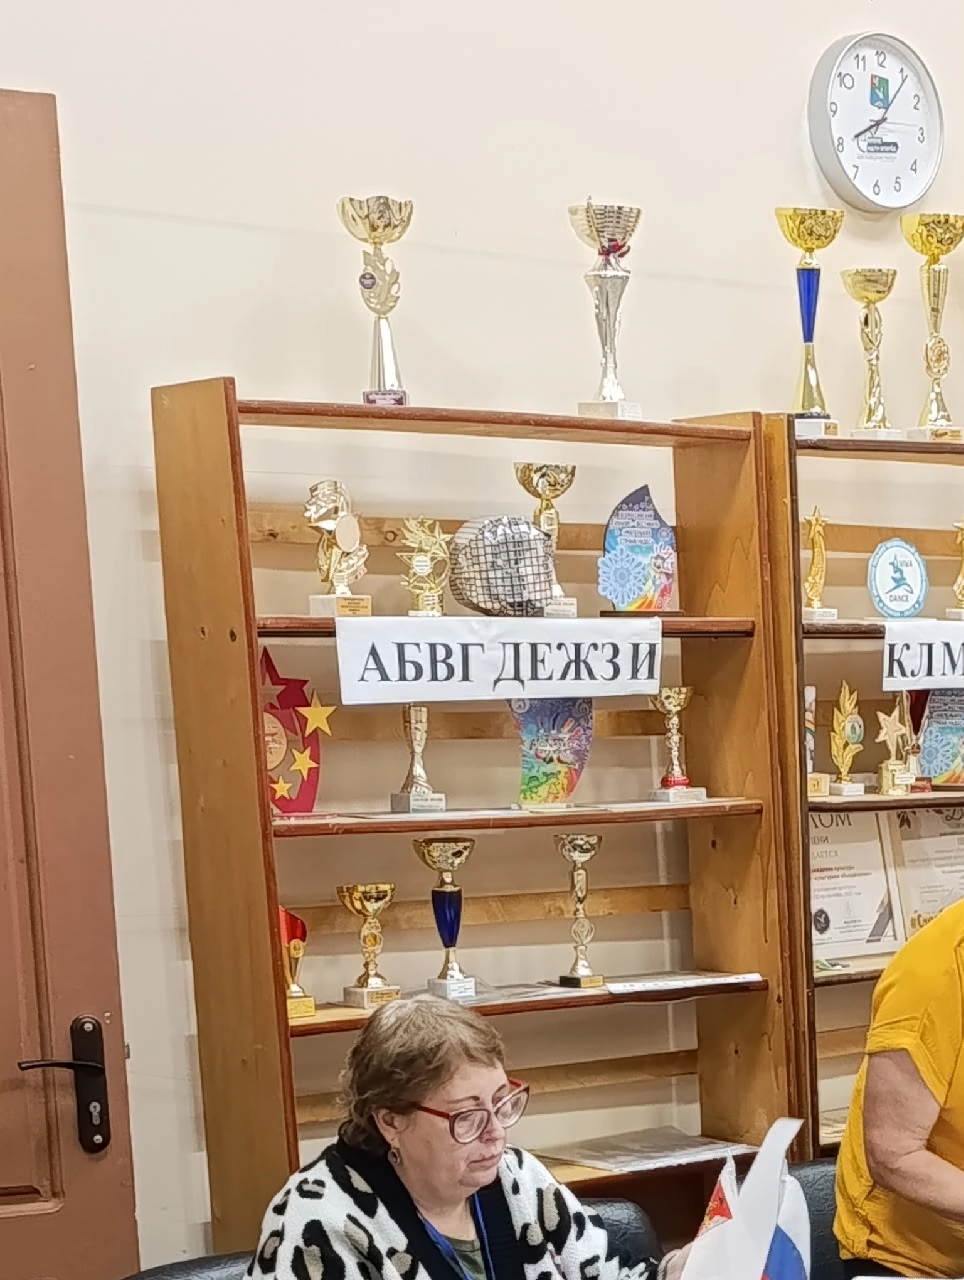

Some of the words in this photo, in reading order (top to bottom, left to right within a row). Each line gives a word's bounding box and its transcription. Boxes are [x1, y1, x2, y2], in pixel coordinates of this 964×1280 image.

[854, 54, 866, 72] 11
[875, 51, 887, 68] 12
[837, 72, 855, 90] 10
[830, 102, 838, 118] 9
[913, 94, 921, 110] 2
[918, 127, 926, 144] 3
[837, 137, 844, 153] 8
[852, 164, 860, 180] 7
[910, 159, 918, 174] 4
[873, 179, 881, 196] 6
[894, 176, 902, 192] 5
